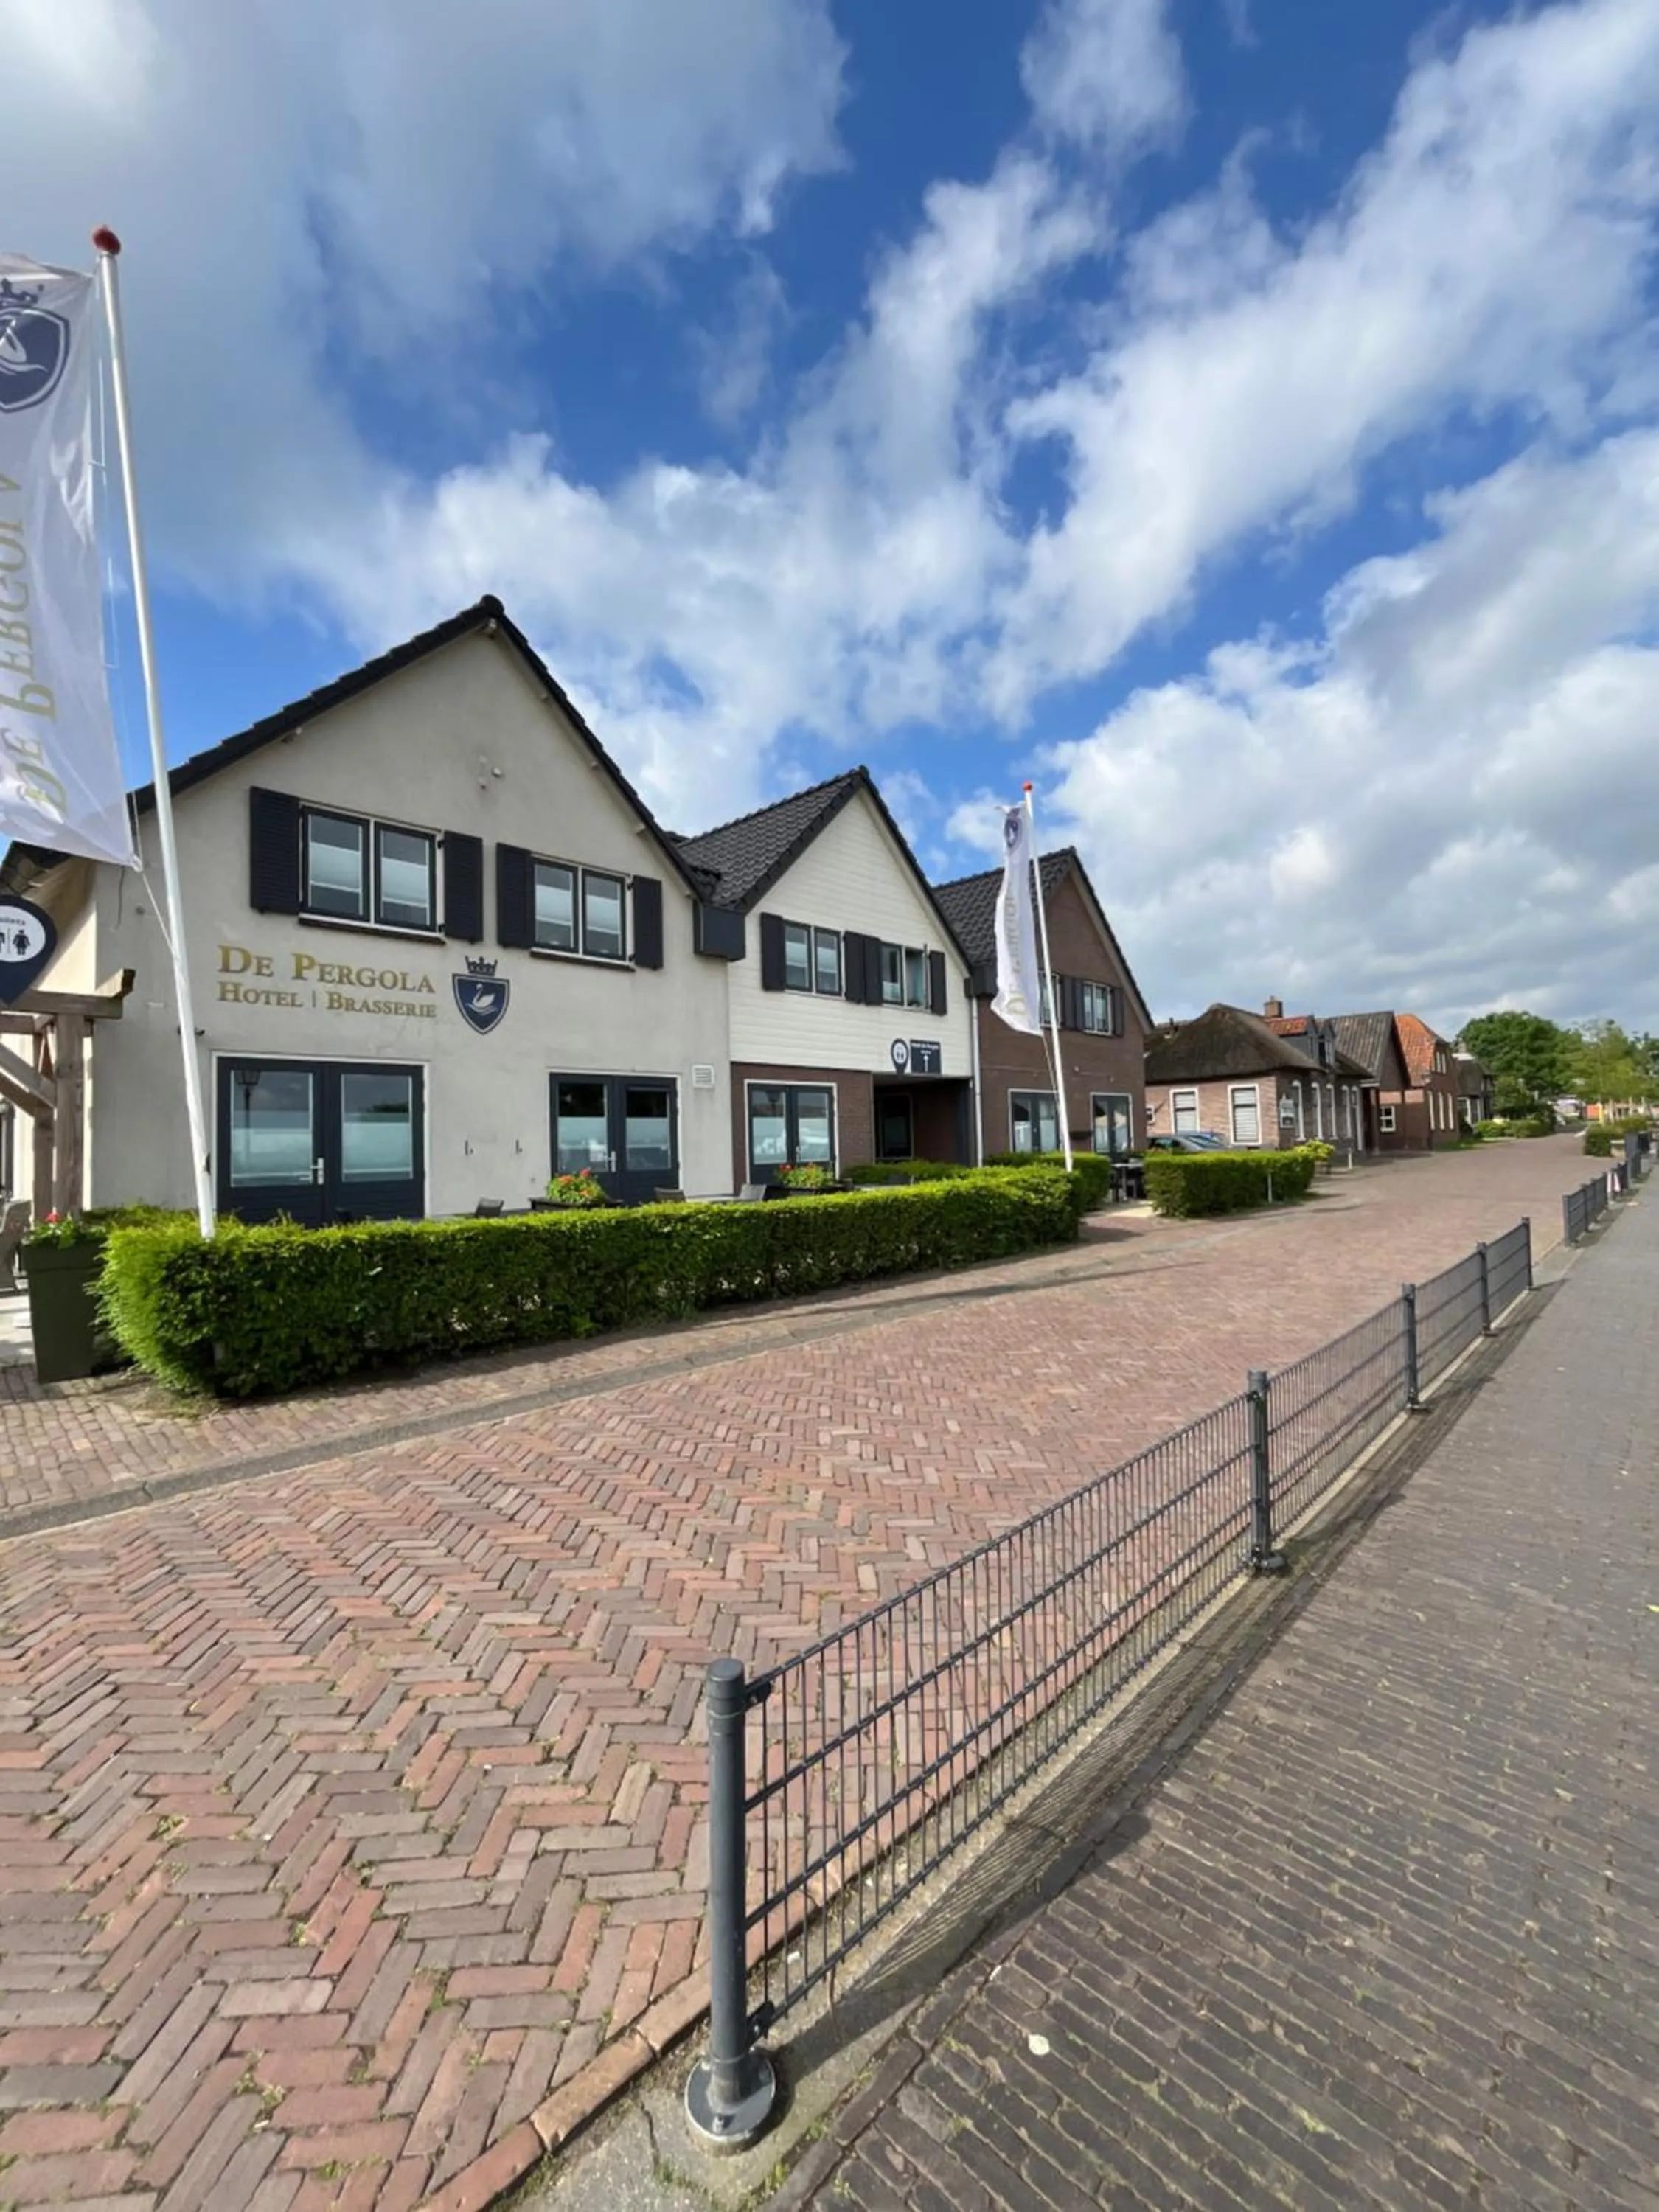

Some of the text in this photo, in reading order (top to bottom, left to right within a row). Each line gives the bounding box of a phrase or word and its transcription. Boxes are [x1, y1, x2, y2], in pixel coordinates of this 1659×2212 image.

[217, 944, 436, 994] DE PERGOLA
[216, 980, 304, 1008] HOTEL
[326, 990, 438, 1018] BRASSERIE
